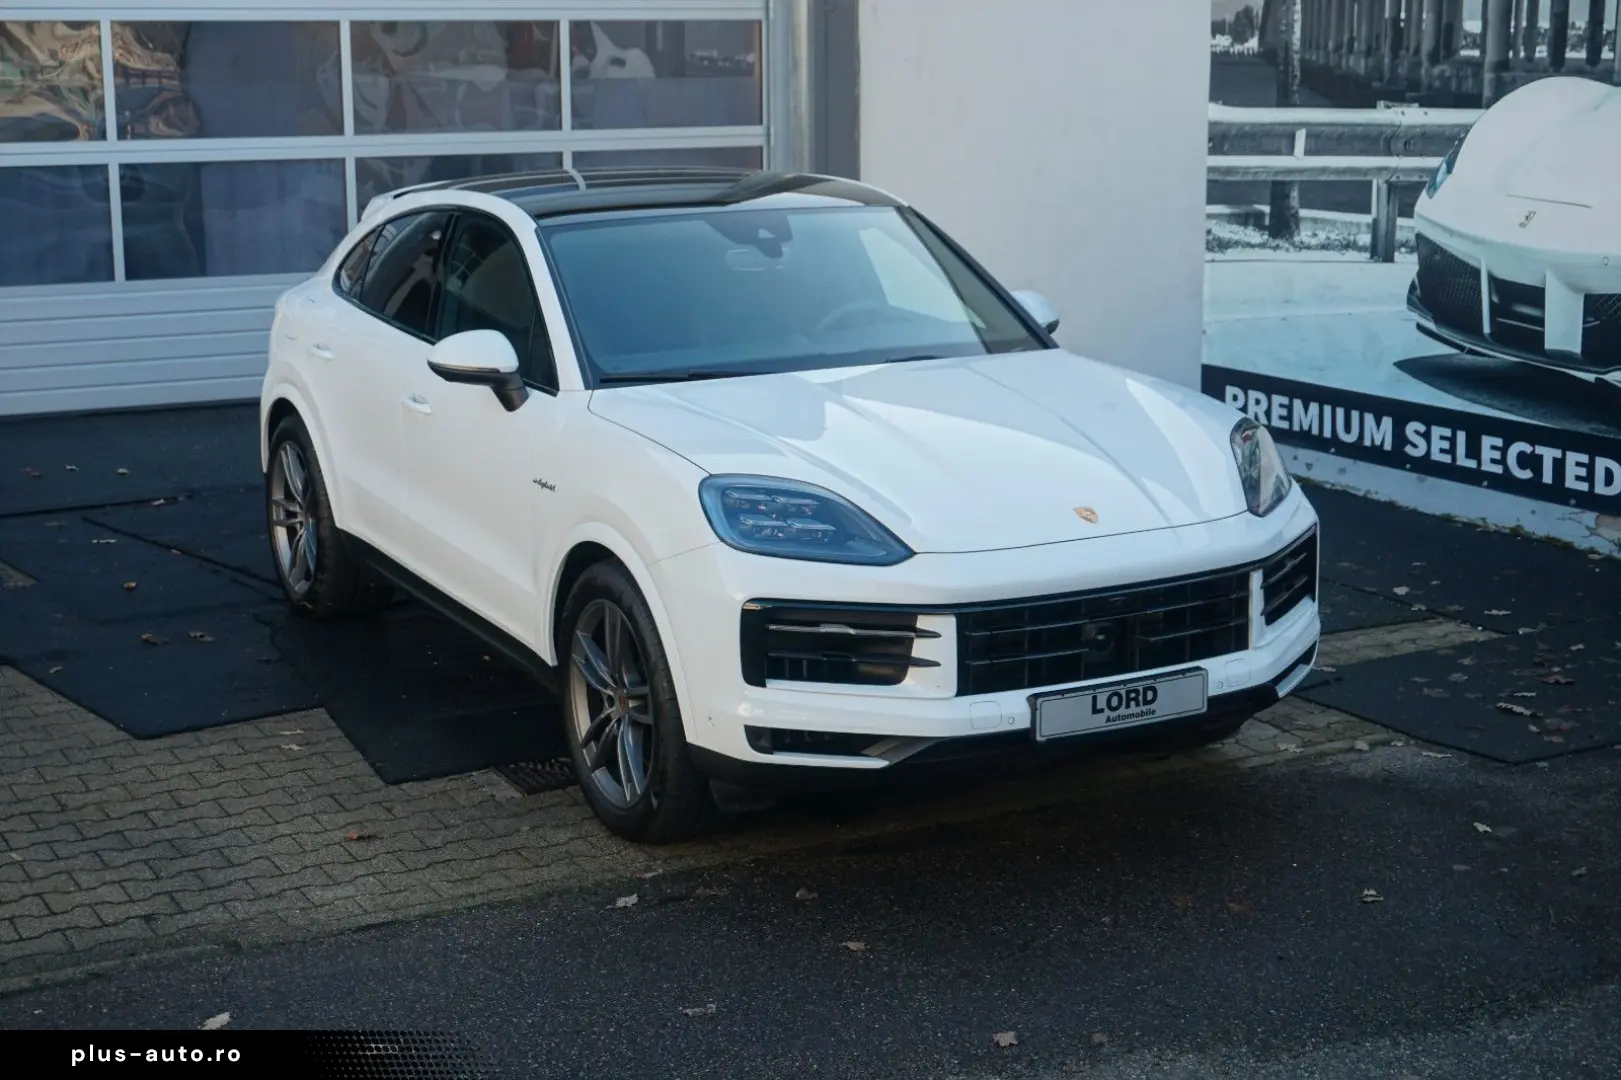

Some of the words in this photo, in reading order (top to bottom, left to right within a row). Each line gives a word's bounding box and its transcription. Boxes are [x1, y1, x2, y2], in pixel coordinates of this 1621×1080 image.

[1224, 384, 1393, 451] PREMIUM
[1404, 420, 1621, 496] SELECTED
[1091, 685, 1158, 715] LORD
[1105, 708, 1157, 724] Automobile
